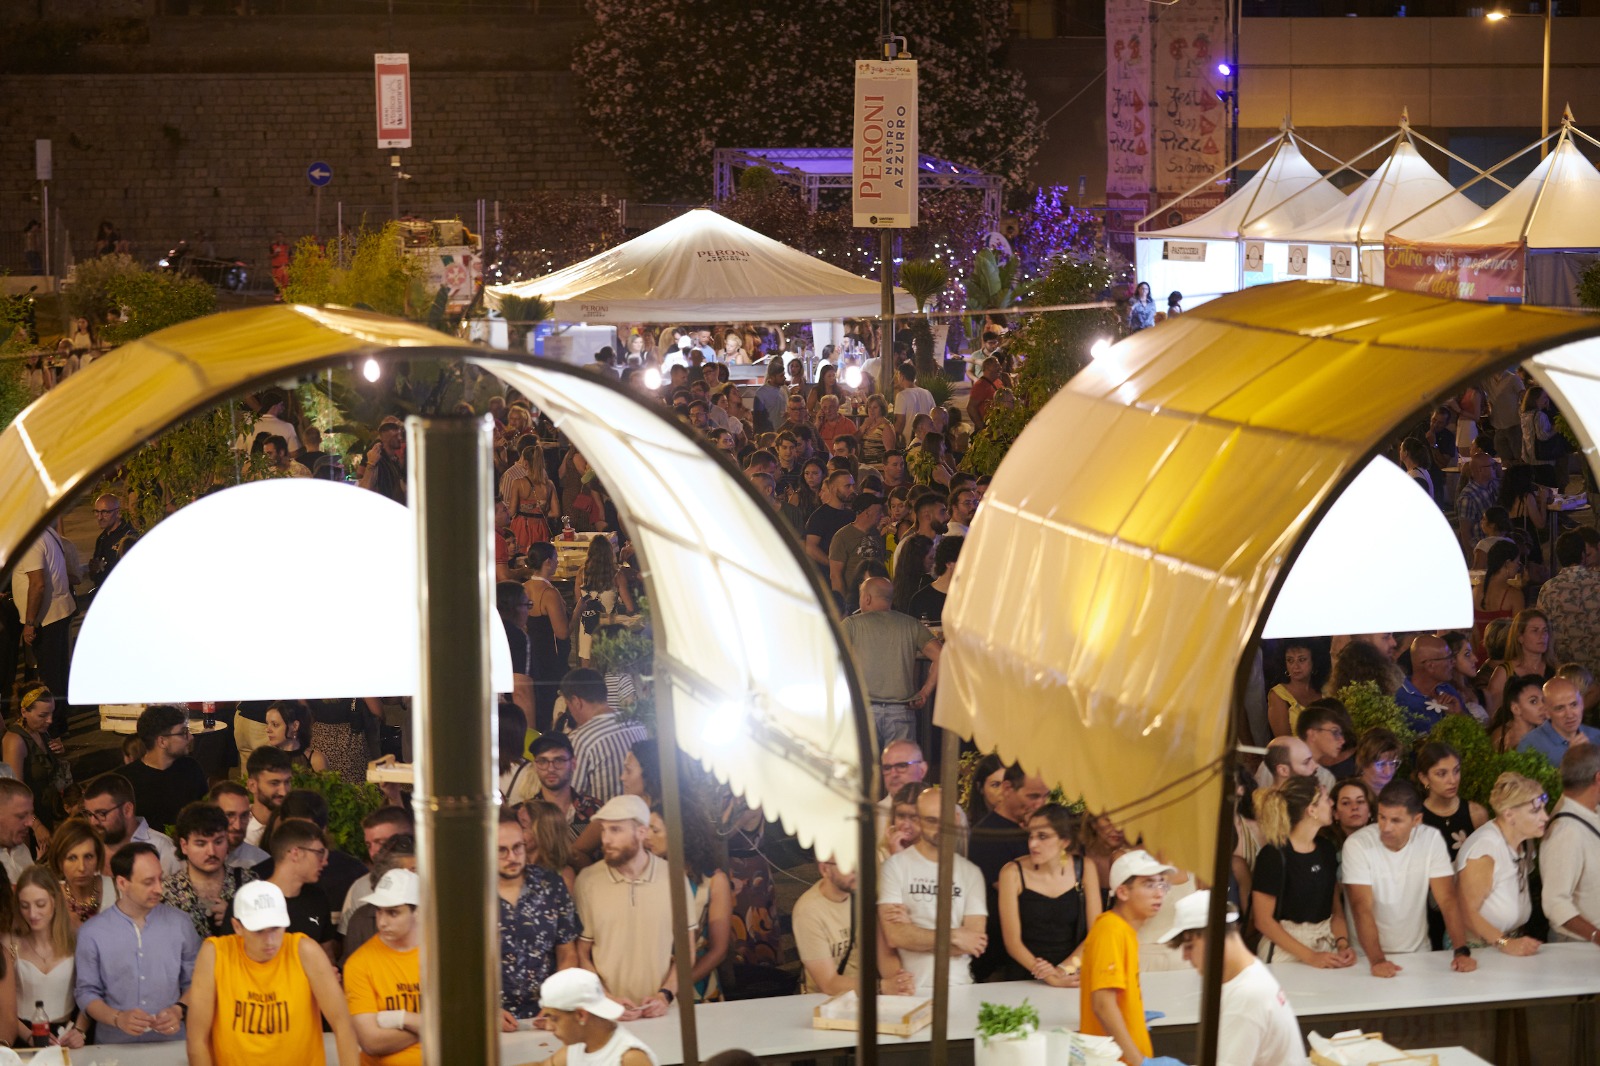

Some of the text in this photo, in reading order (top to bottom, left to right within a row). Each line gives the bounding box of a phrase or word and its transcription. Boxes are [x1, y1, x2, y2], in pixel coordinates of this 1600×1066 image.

[860, 96, 884, 199] PERONI
[885, 120, 894, 175] NASTRO
[895, 106, 906, 188] AZZURRO
[697, 249, 750, 258] PERONI
[1386, 240, 1423, 268] Entra
[1427, 255, 1432, 265] e
[581, 304, 609, 312] PERONI
[248, 991, 277, 1002] MOLINI
[232, 1001, 290, 1034] PIZZUTI
